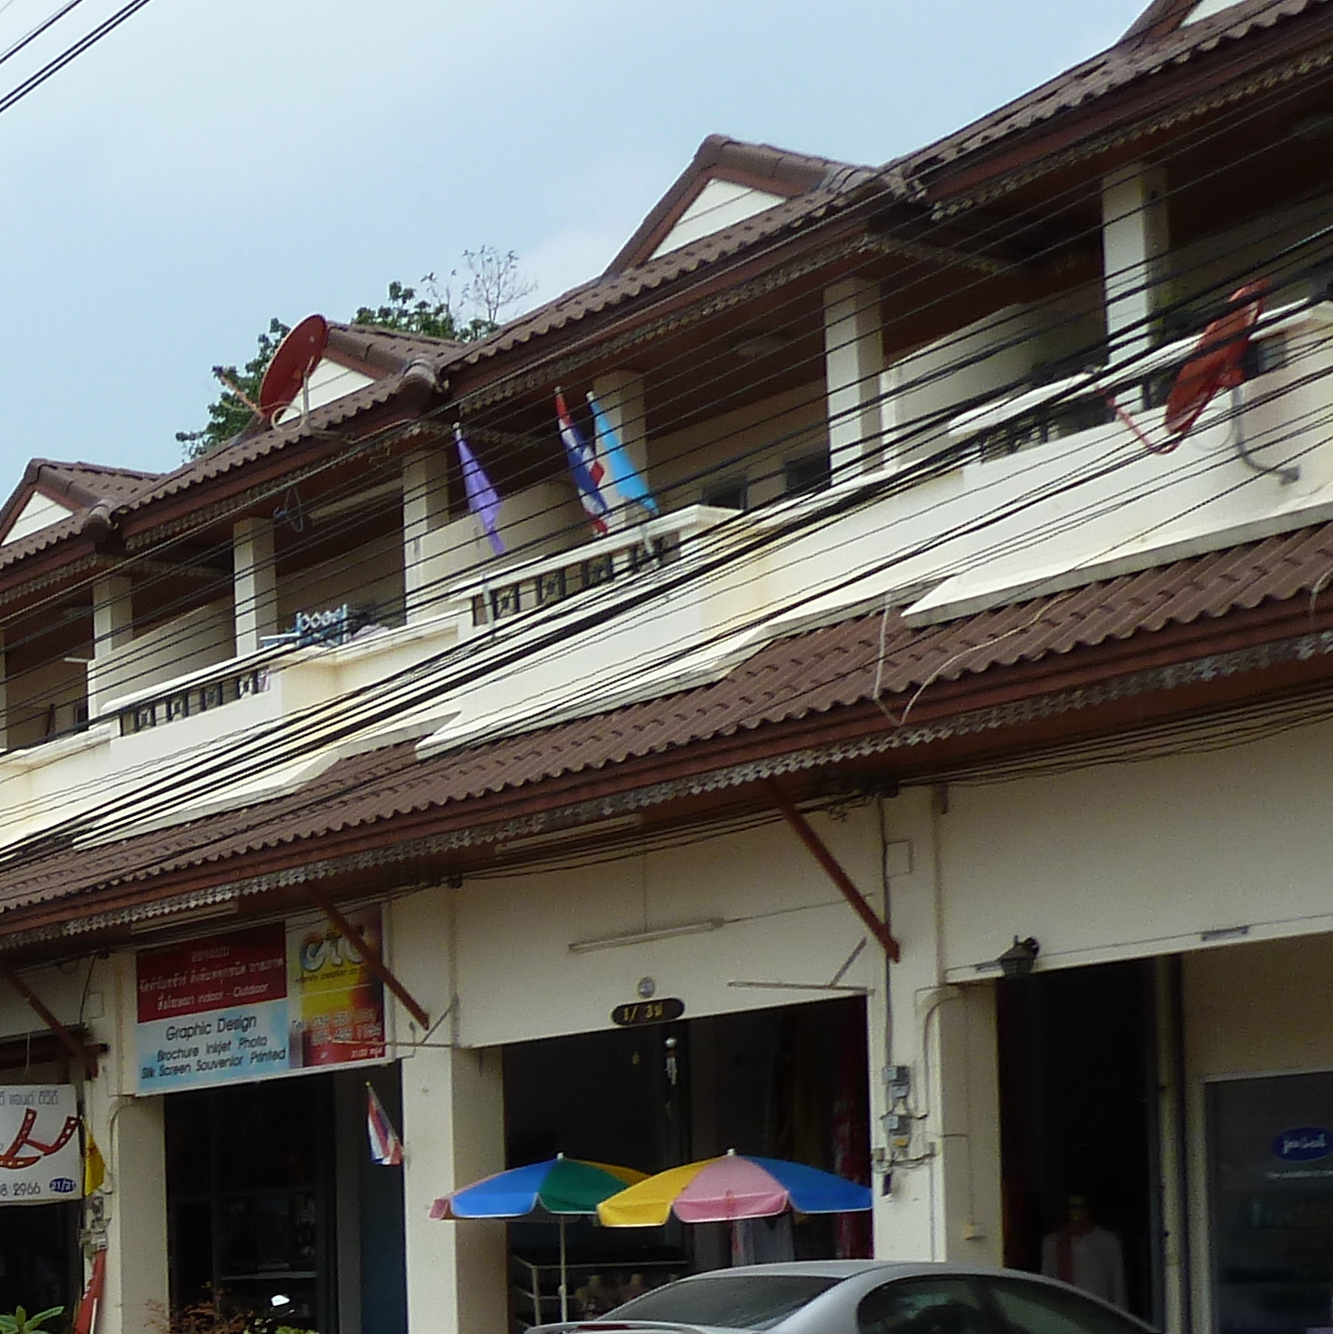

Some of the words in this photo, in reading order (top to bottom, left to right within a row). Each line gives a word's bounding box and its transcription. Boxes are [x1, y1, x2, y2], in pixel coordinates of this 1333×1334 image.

[166, 1021, 212, 1041] Graphic
[217, 1014, 256, 1033] Design
[156, 1046, 199, 1062] Brochure
[206, 1040, 231, 1056] Inkjet
[238, 1035, 267, 1049] Photo
[159, 1062, 191, 1077] Screen
[250, 1047, 286, 1064] Printed
[13, 1182, 41, 1196] 2966
